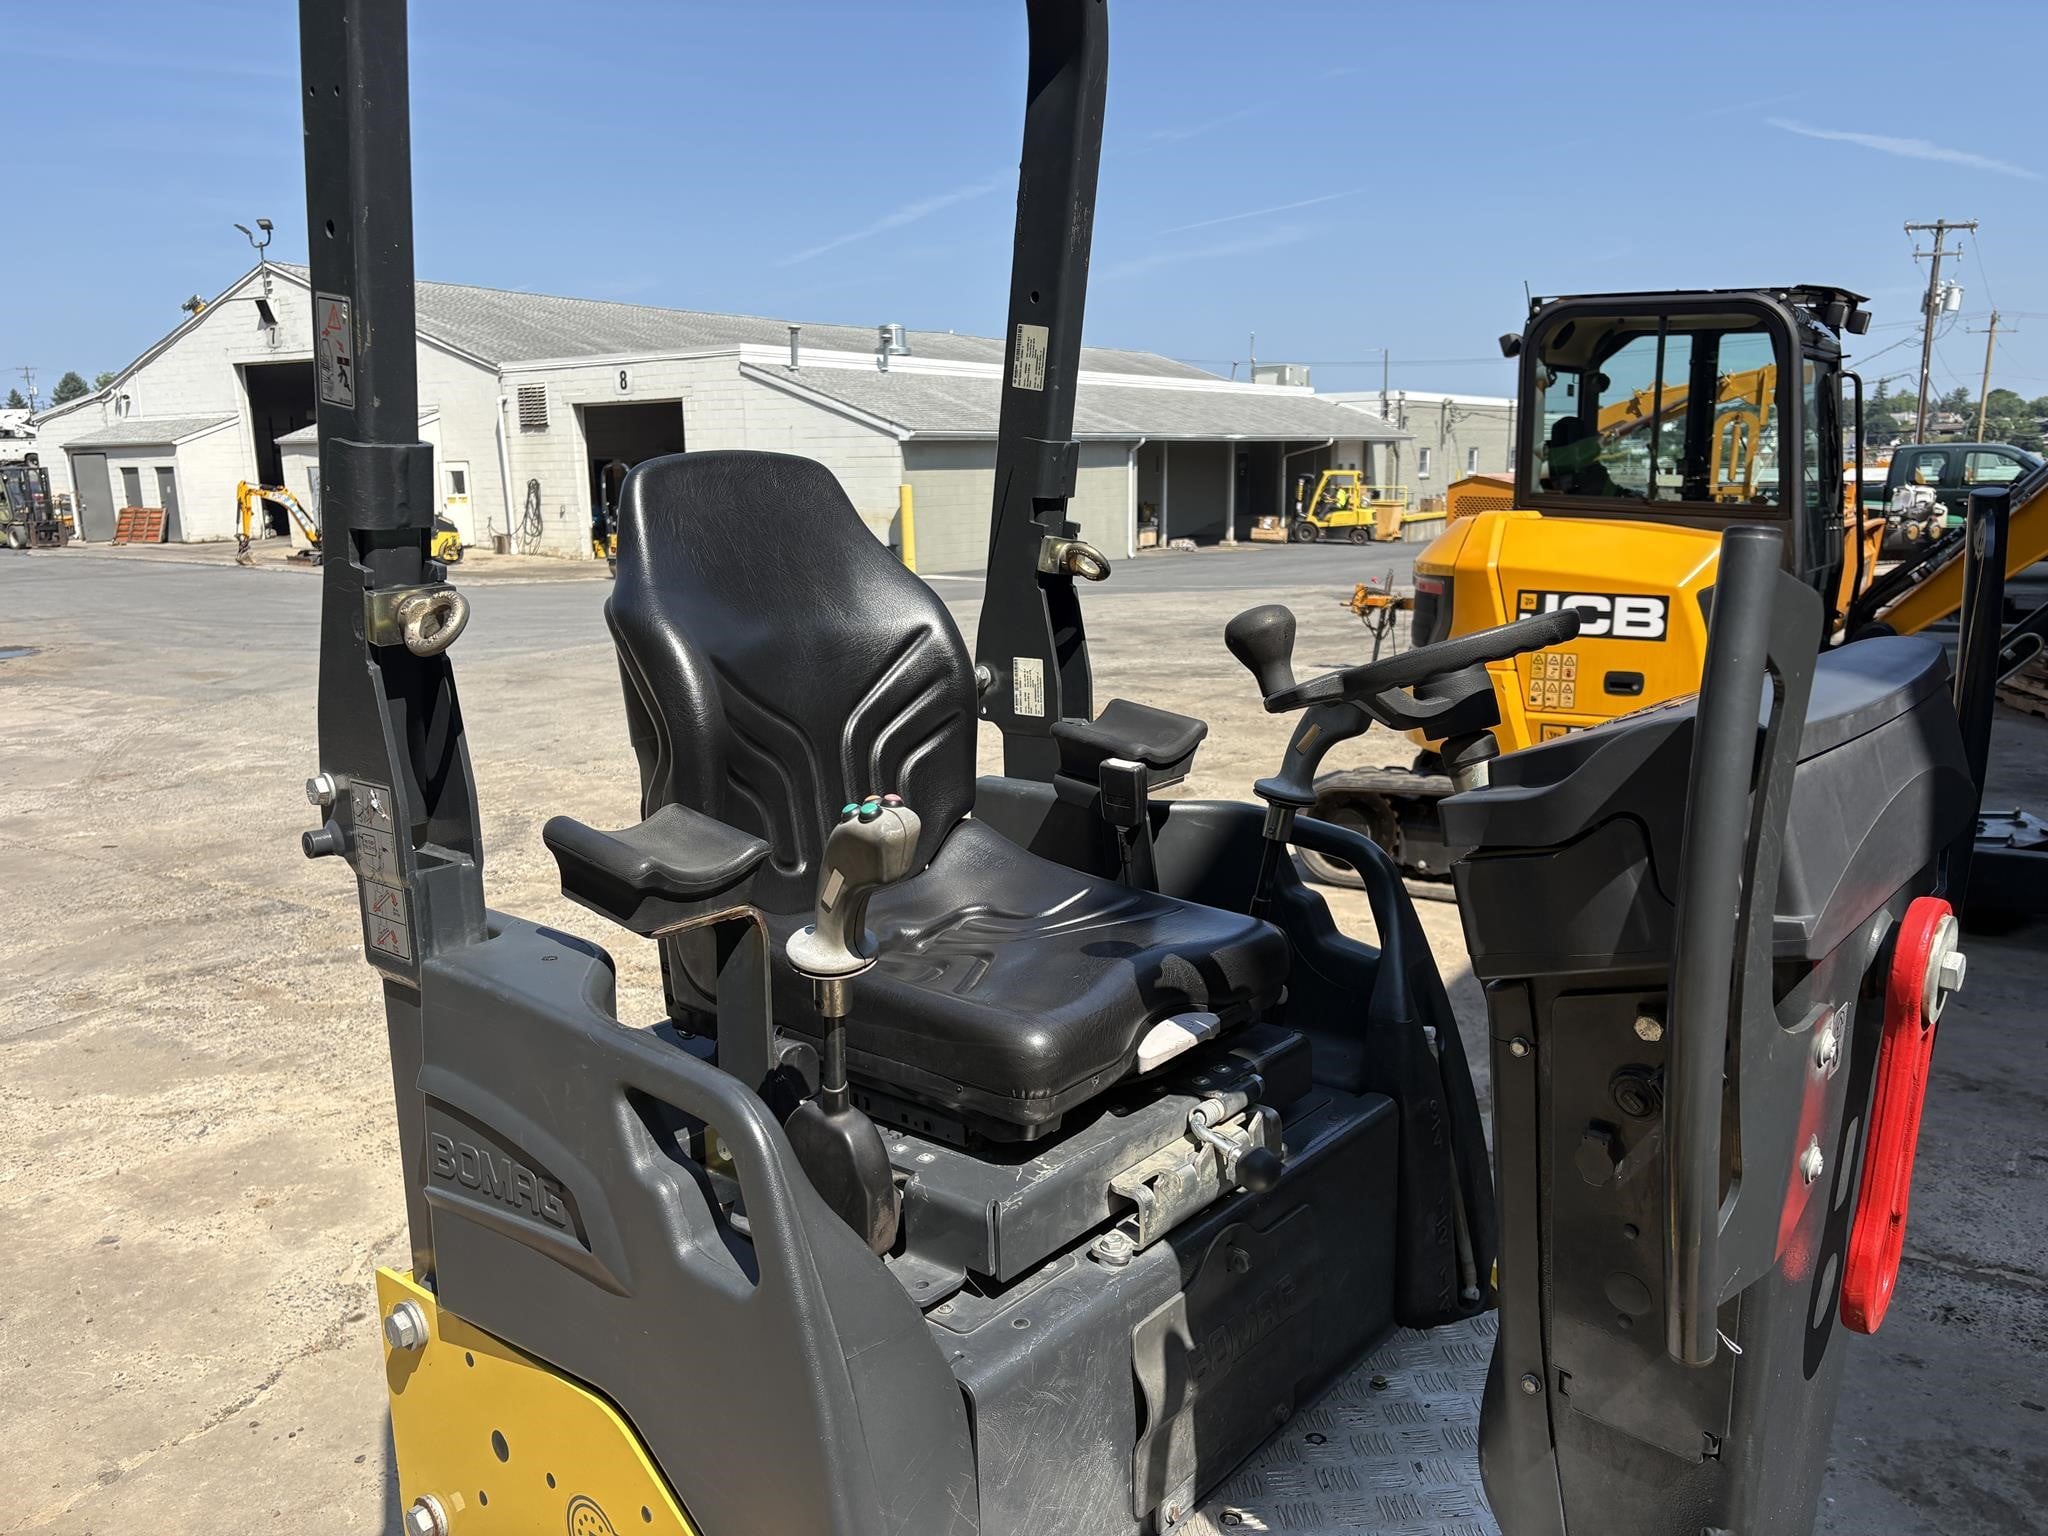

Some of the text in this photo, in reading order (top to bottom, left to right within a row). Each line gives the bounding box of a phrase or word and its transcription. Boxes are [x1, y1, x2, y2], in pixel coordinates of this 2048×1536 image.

[269, 327, 276, 345] 7
[619, 370, 628, 390] 8
[432, 1132, 567, 1228] BOMAG
